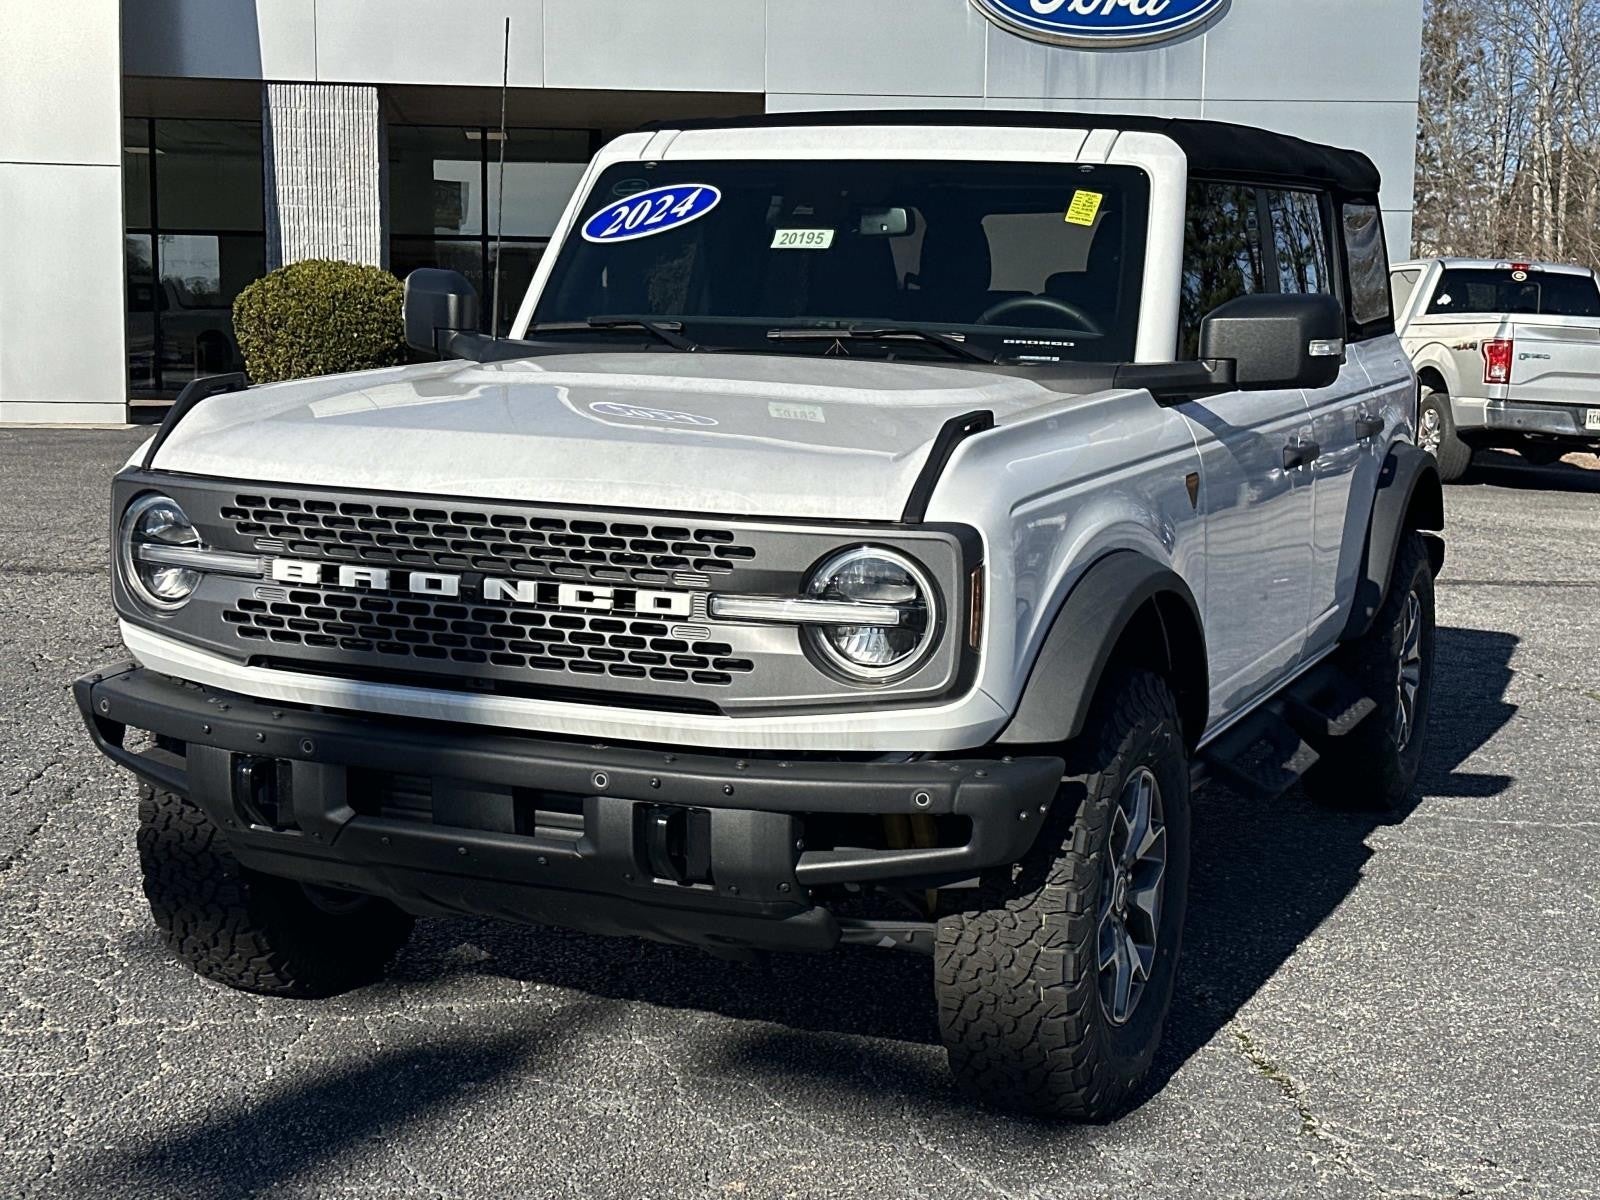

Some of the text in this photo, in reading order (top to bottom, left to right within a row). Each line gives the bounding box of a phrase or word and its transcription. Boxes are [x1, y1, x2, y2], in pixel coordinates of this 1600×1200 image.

[599, 187, 703, 238] 2024
[778, 231, 825, 246] 20195
[271, 557, 693, 617] BRONCO
